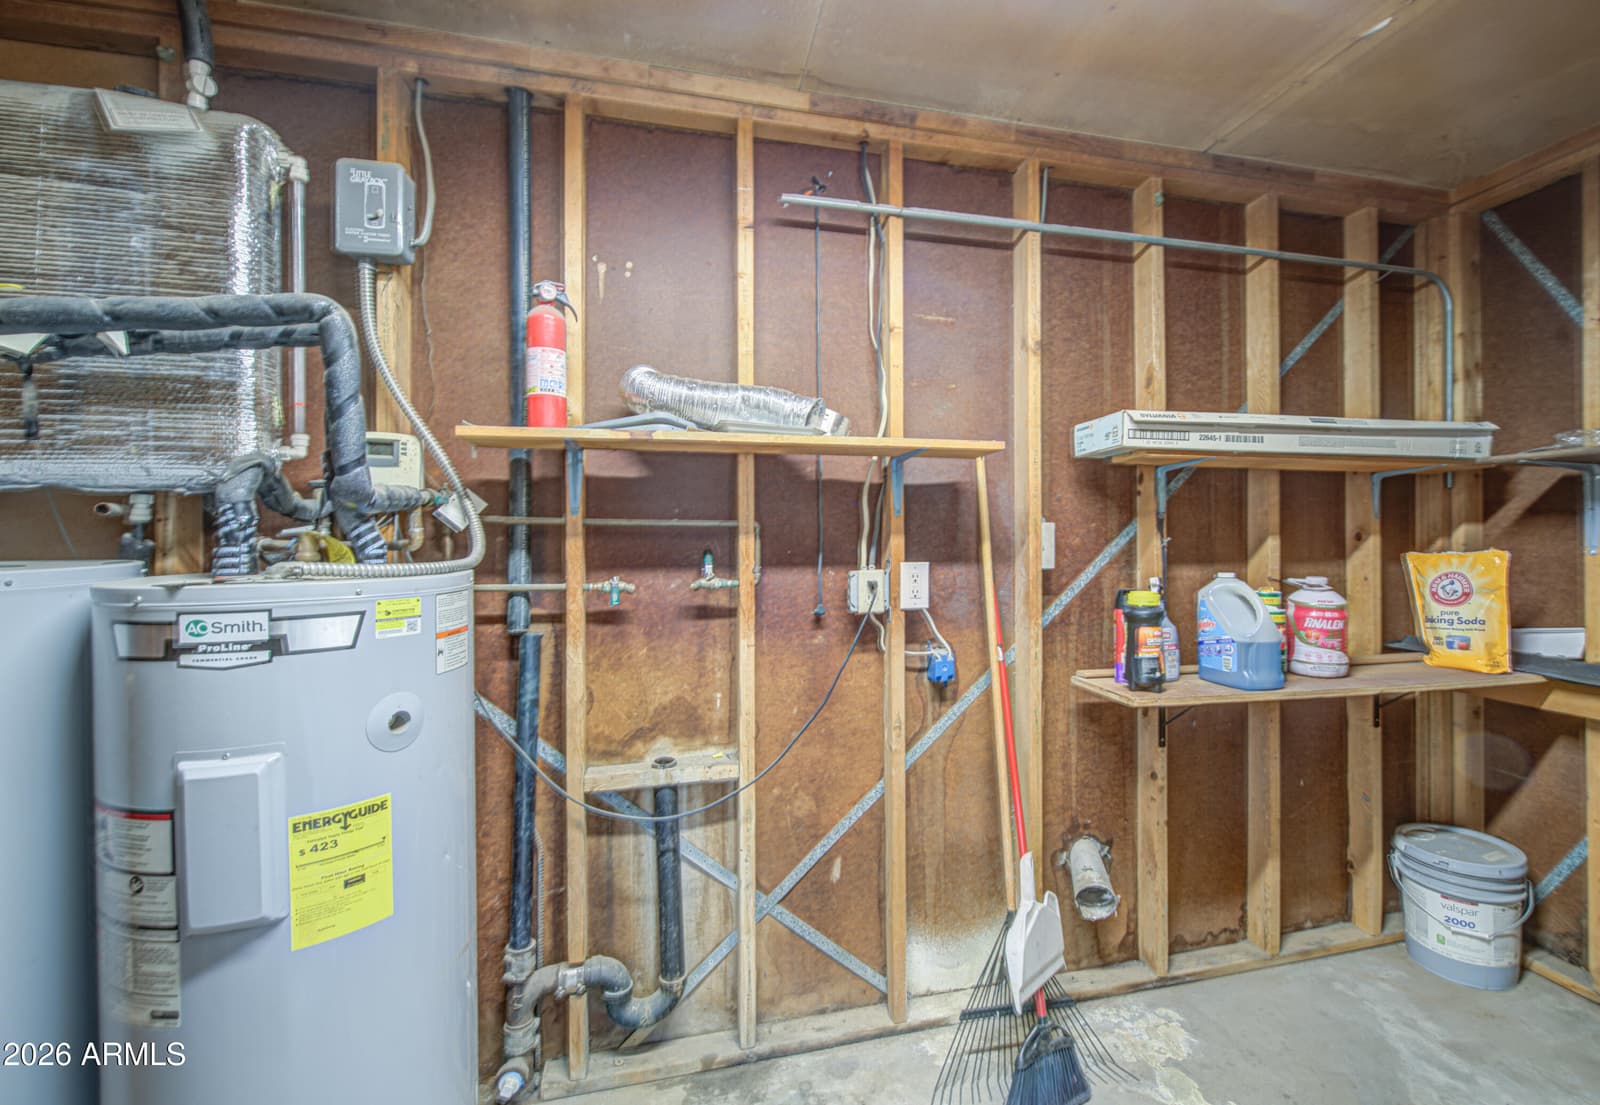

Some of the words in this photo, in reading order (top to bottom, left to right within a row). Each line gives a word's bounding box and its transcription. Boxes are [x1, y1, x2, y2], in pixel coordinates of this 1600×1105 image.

[211, 620, 263, 634] Smith
[1425, 615, 1454, 626] king
[1456, 616, 1486, 626] Soda
[198, 643, 253, 653] ProLine
[310, 839, 338, 853] 423
[1441, 902, 1480, 917] valspar
[1444, 915, 1476, 929] 2000
